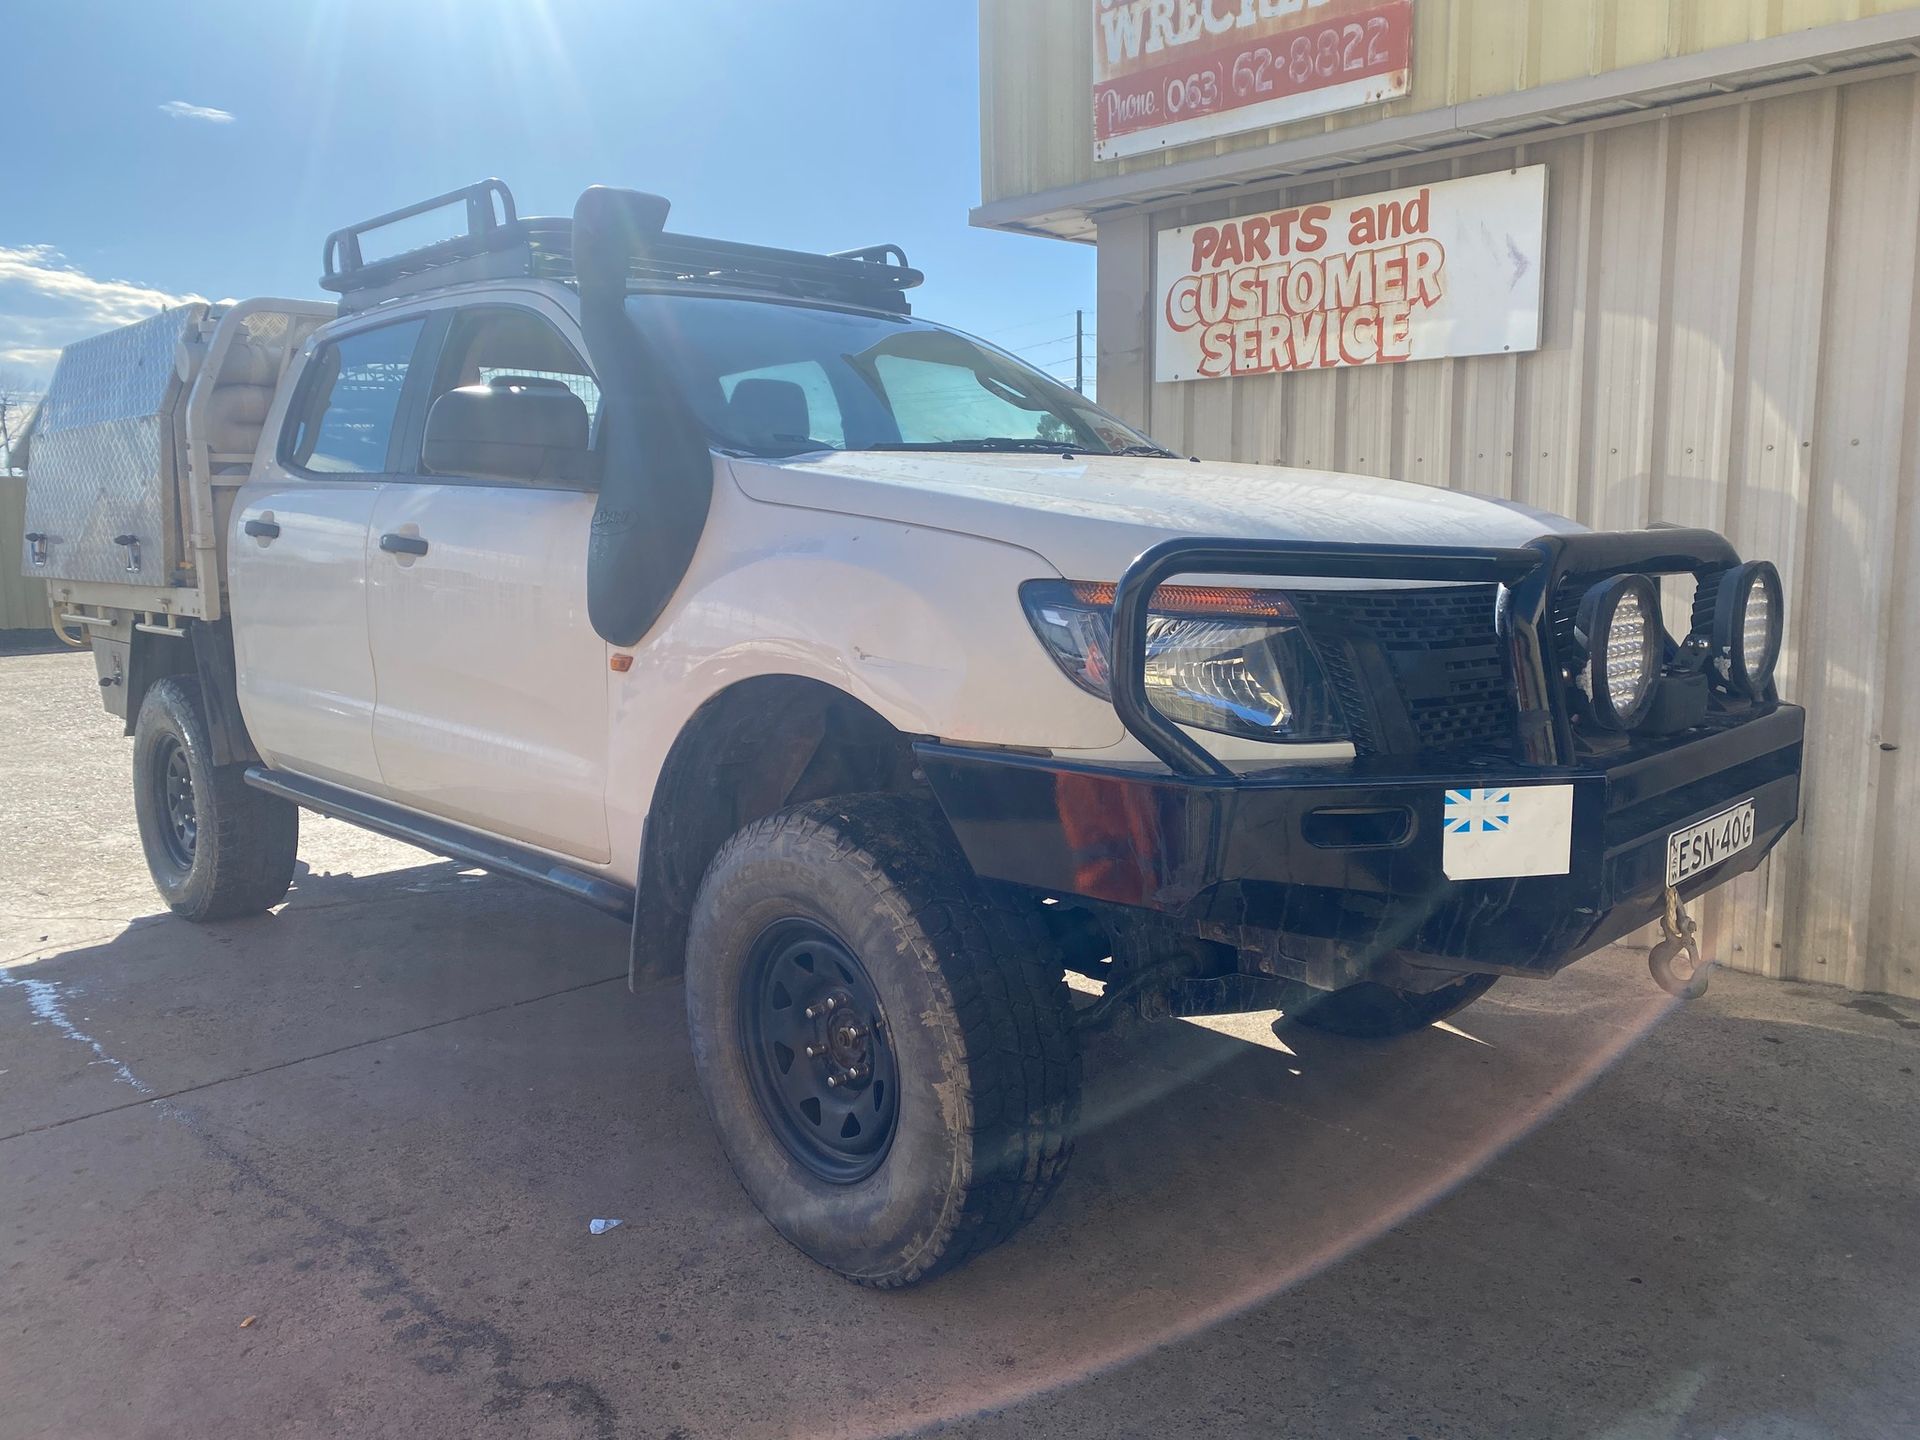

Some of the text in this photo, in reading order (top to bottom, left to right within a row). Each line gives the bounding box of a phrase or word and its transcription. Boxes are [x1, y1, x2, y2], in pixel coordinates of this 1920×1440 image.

[1162, 61, 1223, 119] (063)
[1191, 188, 1430, 272] PARTS and
[1166, 238, 1445, 332] CUSTOMER
[1199, 301, 1413, 377] SERVICE
